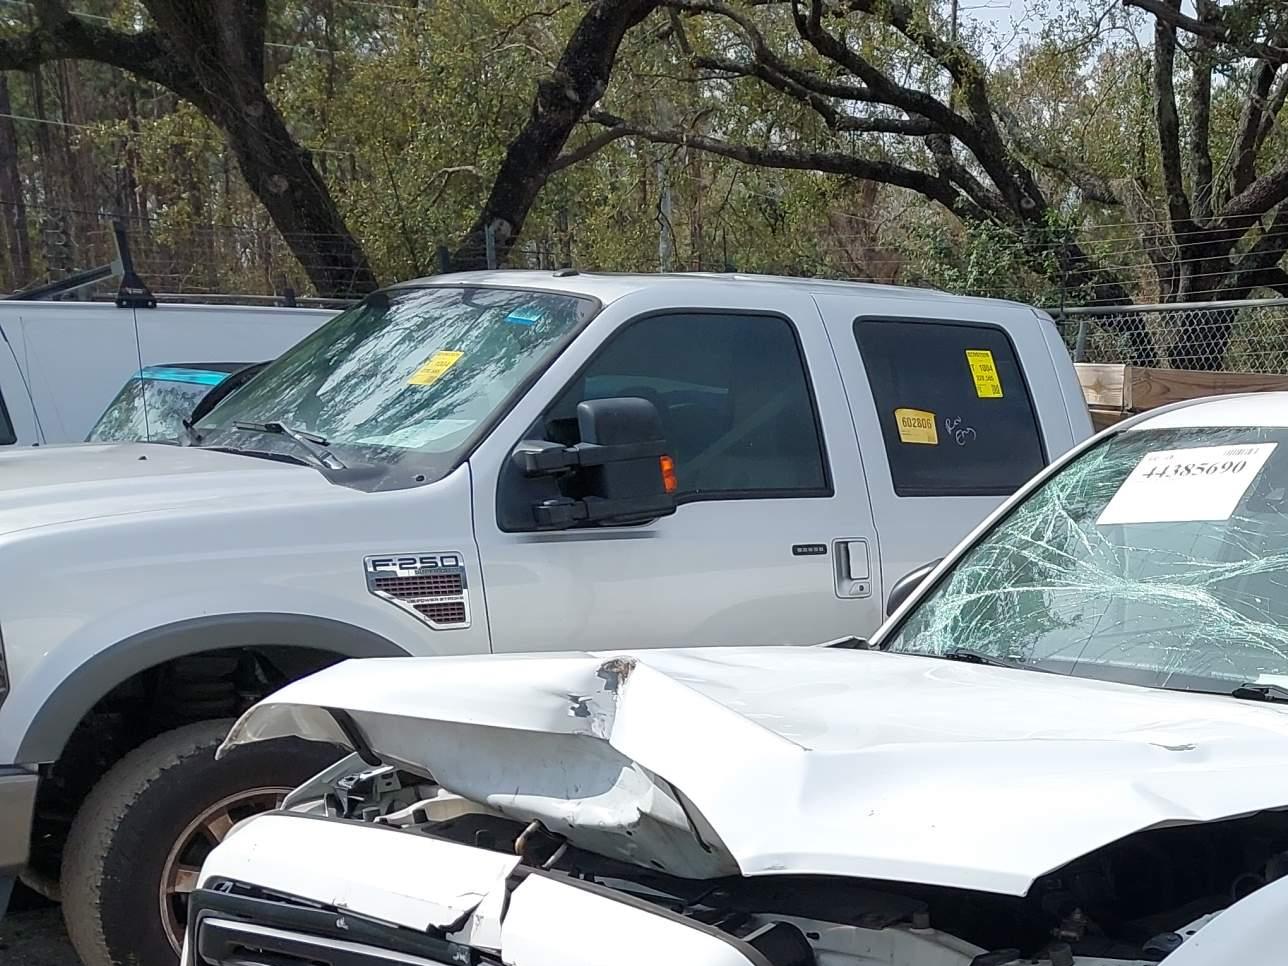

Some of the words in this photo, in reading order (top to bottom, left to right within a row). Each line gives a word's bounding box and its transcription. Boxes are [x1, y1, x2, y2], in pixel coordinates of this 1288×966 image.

[901, 416, 932, 429] 602806
[1142, 460, 1247, 479] 44385690
[371, 555, 460, 572] F-250
